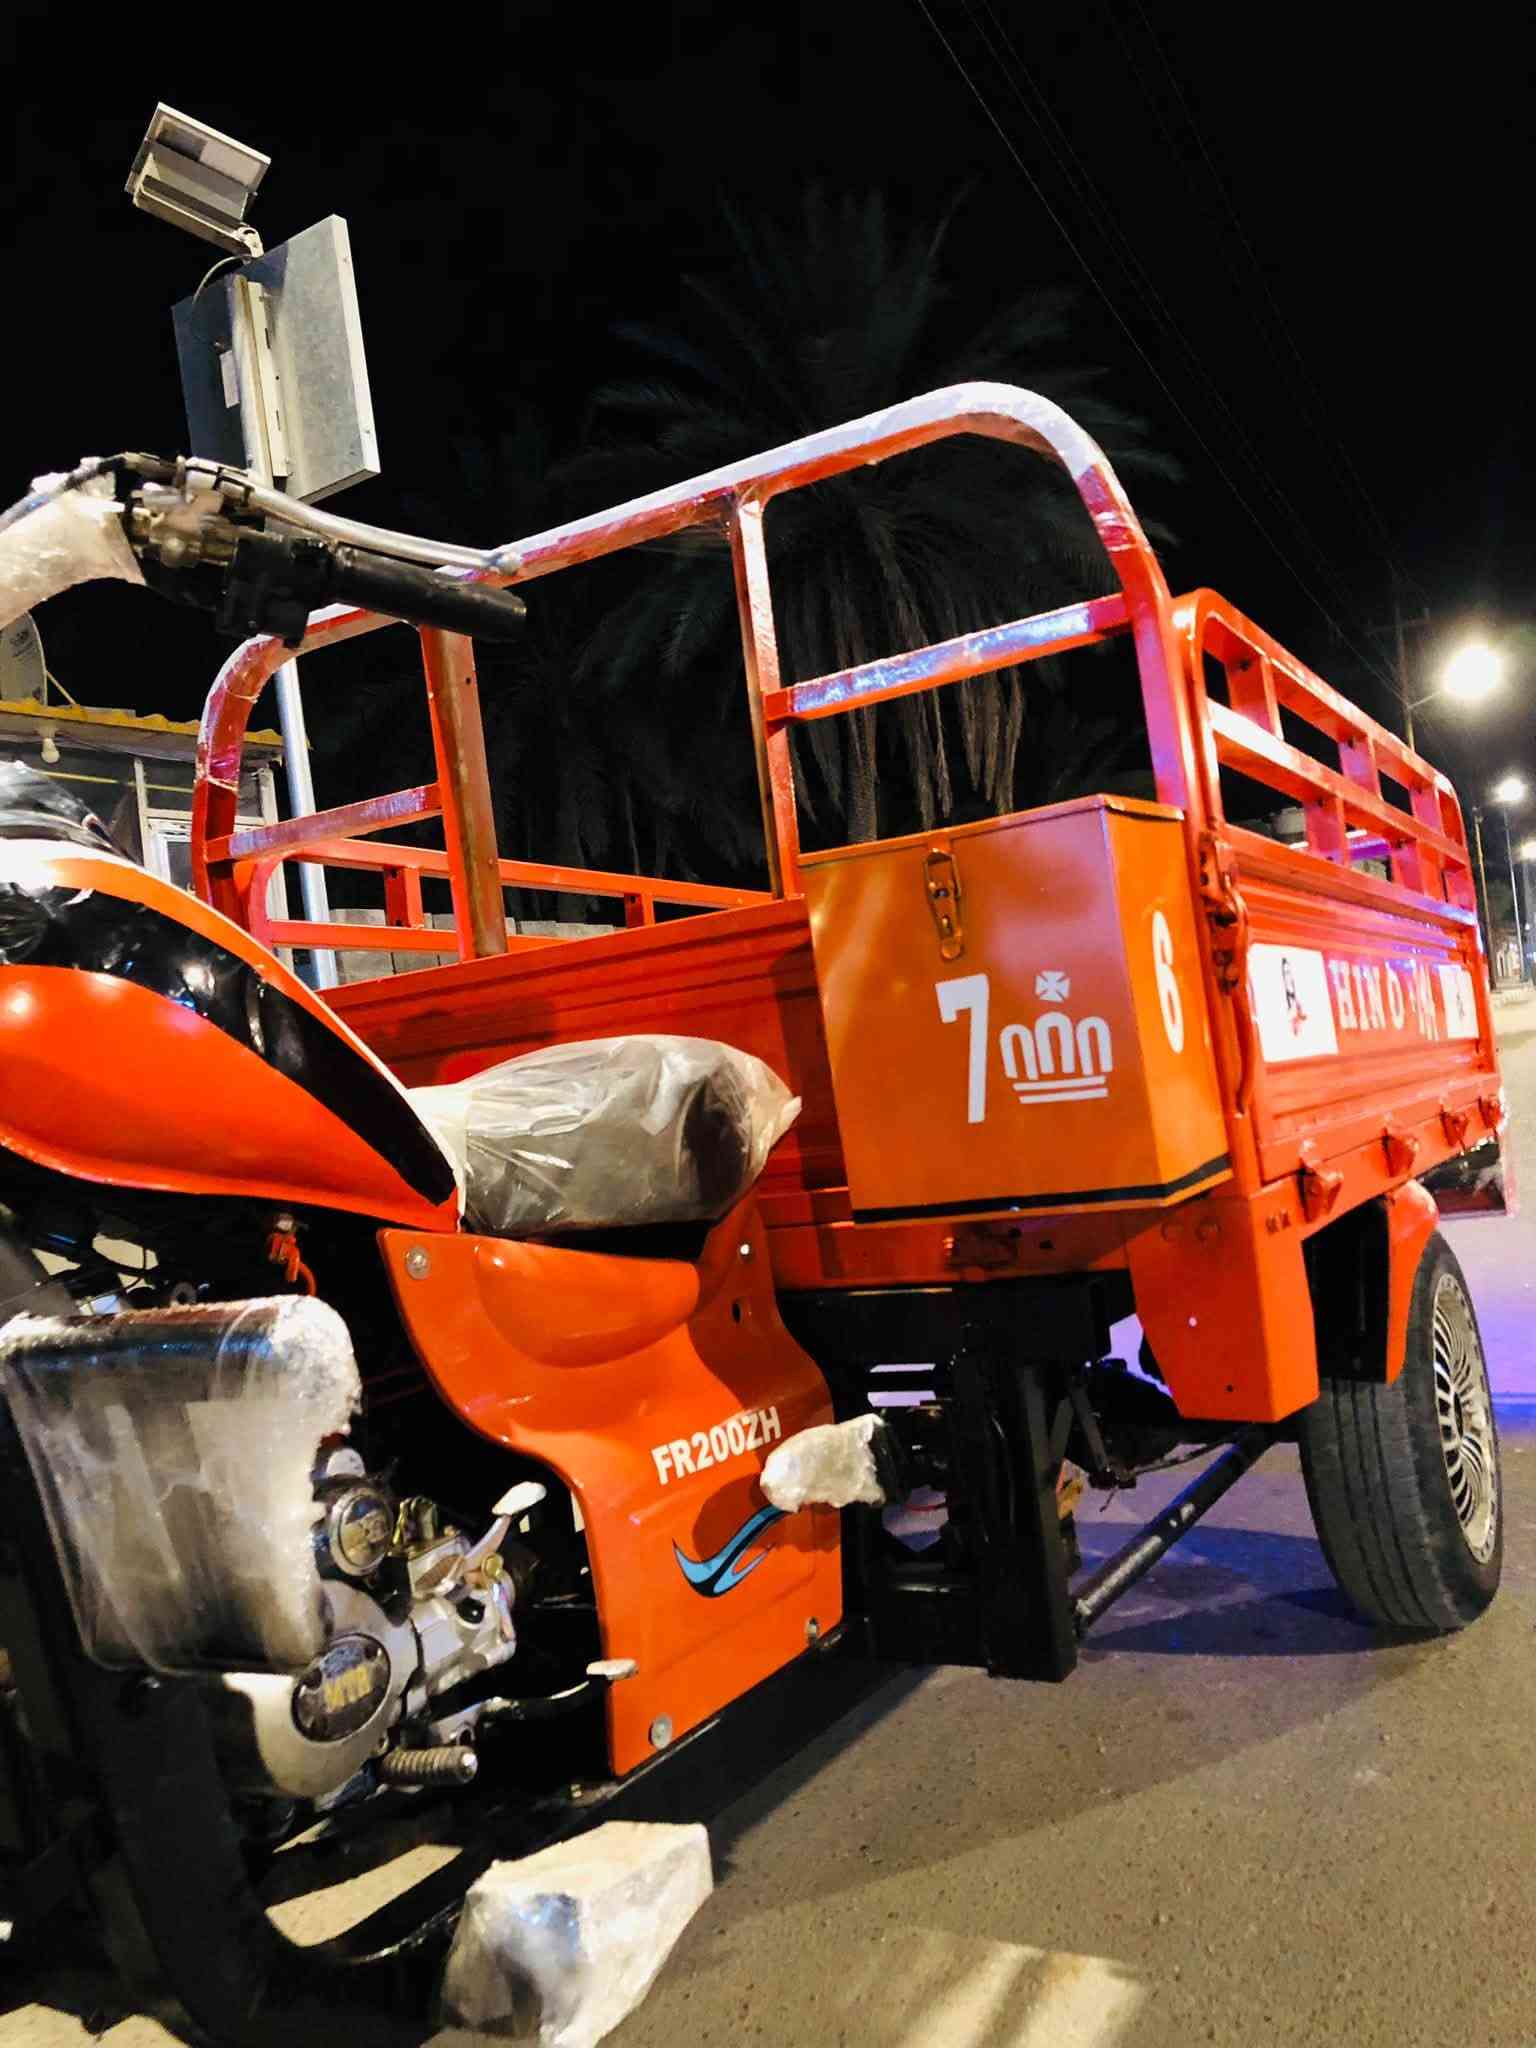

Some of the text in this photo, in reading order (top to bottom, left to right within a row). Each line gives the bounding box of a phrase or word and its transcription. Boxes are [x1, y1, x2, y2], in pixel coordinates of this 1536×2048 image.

[935, 973, 990, 1125] 7
[1152, 910, 1185, 1054] 6
[651, 1405, 783, 1486] FR200ZH
